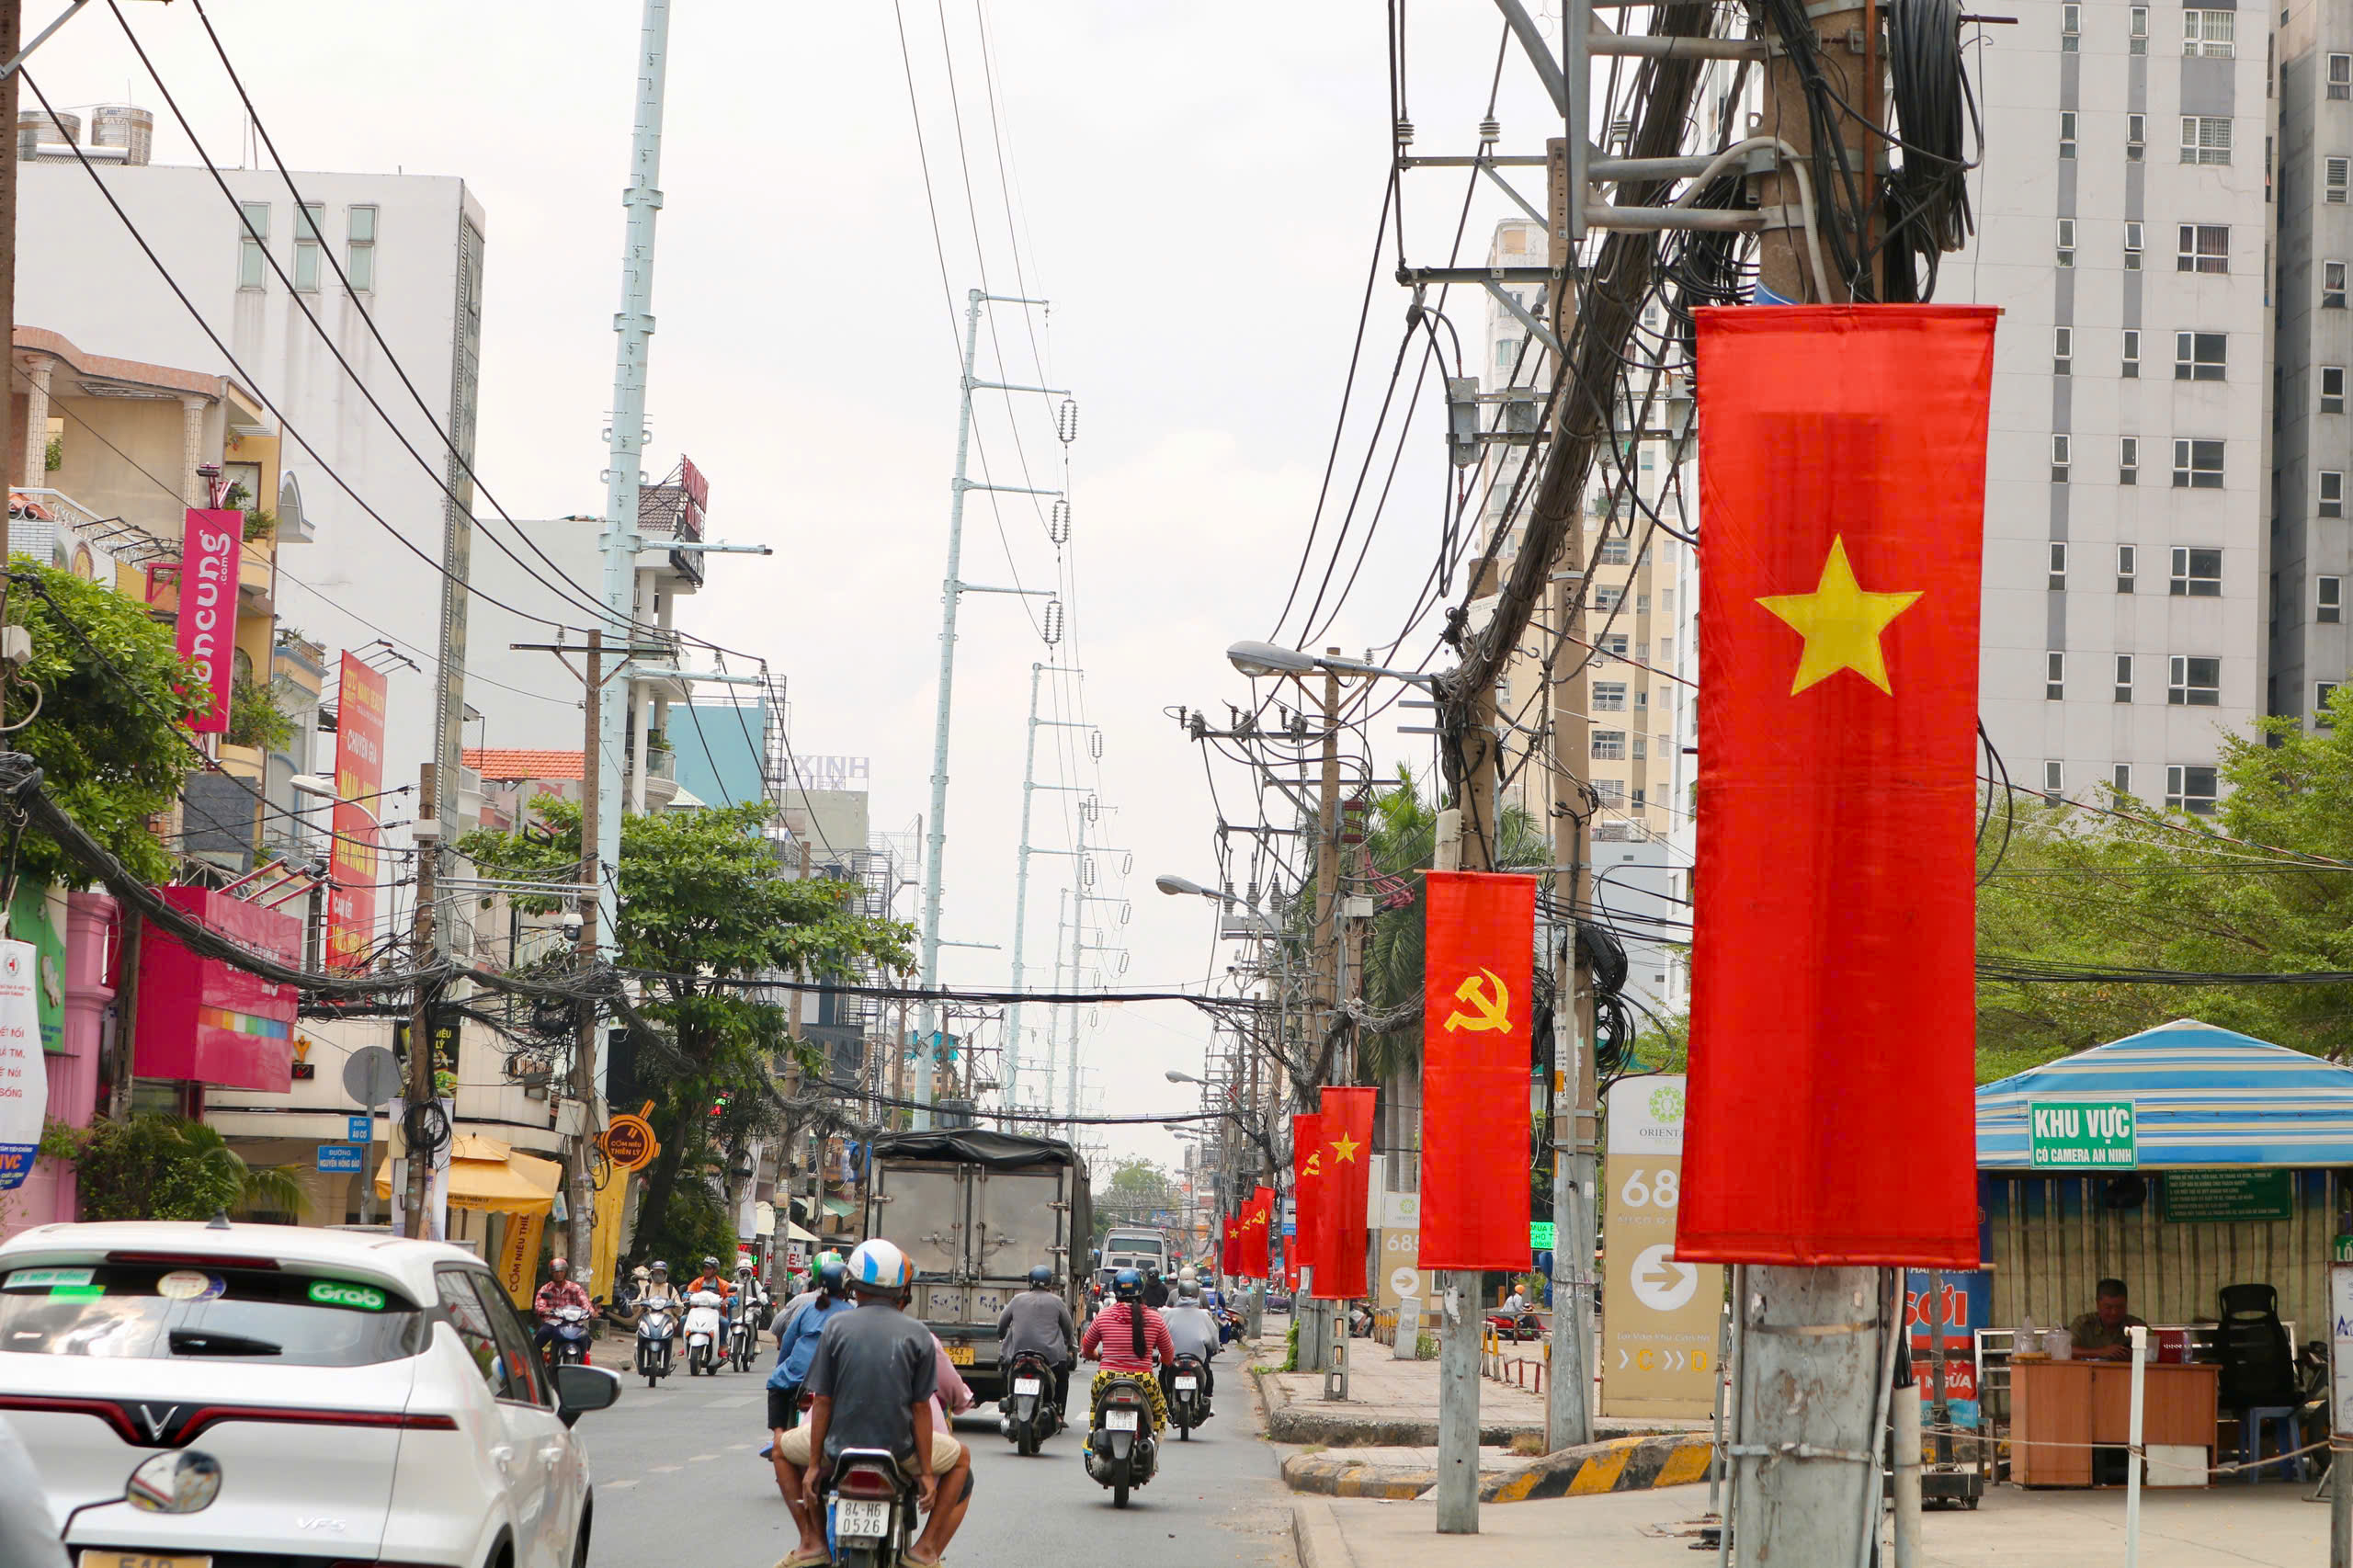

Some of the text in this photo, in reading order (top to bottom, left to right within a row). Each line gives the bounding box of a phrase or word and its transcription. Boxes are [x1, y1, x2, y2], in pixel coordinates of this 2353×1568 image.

[2035, 1107, 2130, 1144] KHU VỰC
[611, 1147, 631, 1155] THIÊN
[2036, 1145, 2131, 1163] CÓ CAMERA AN NINH
[1621, 1169, 1679, 1209] 68
[313, 1284, 381, 1307] Grab
[1638, 1348, 1707, 1371] C D
[846, 1502, 881, 1517] 84-H6
[844, 1518, 881, 1534] 0526
